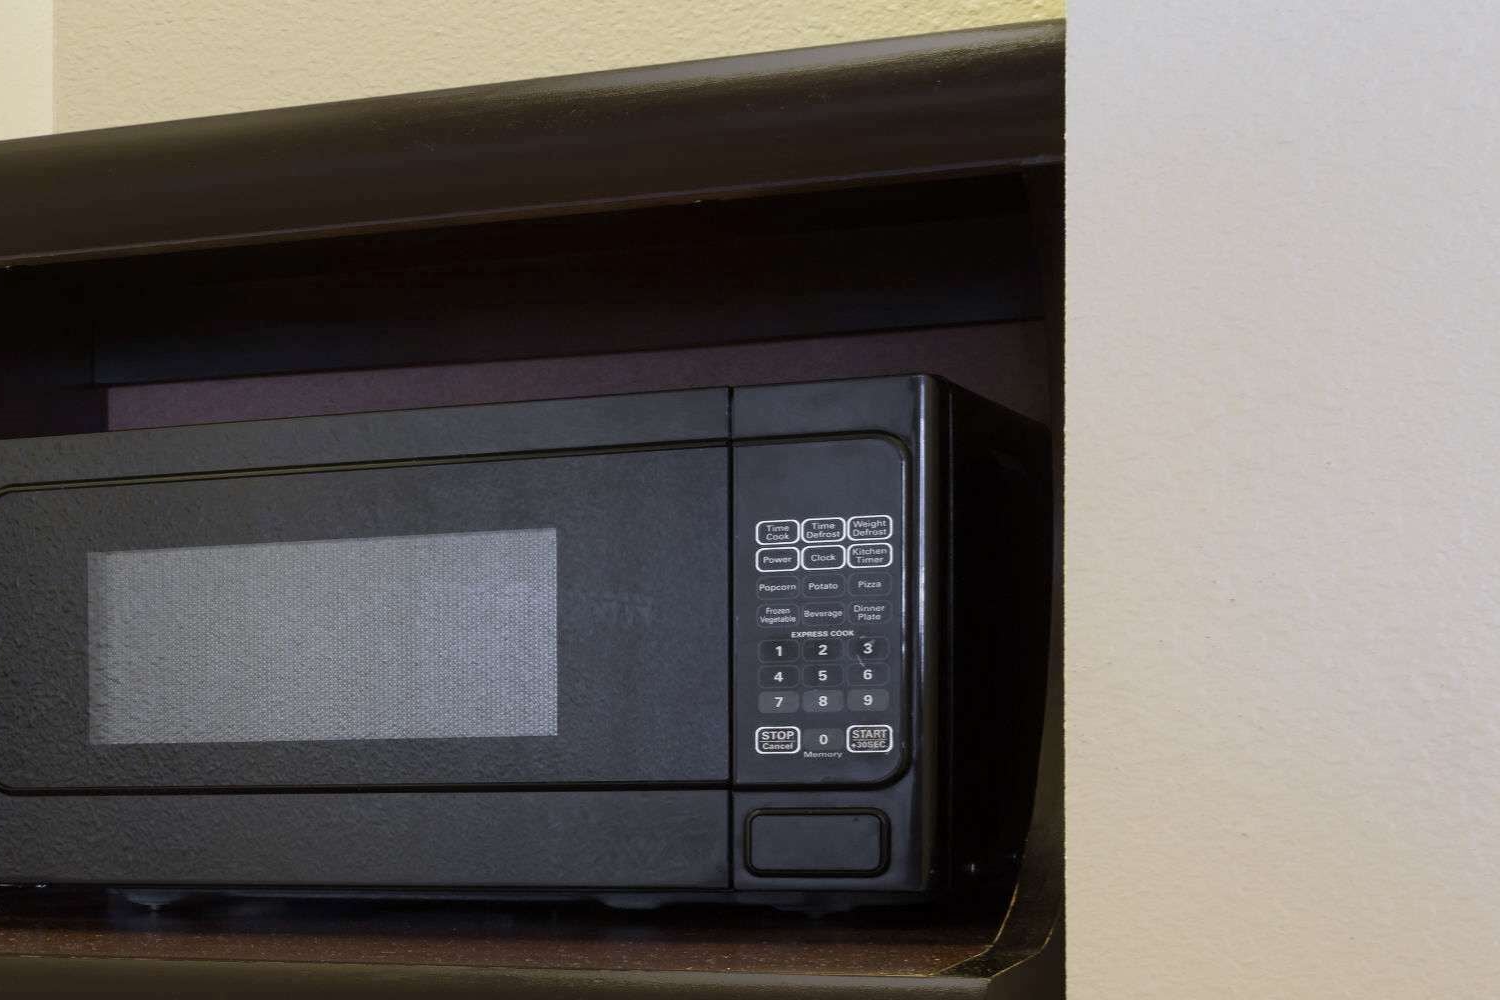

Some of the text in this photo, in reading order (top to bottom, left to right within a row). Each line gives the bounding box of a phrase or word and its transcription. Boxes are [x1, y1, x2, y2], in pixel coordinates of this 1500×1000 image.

[853, 520, 887, 528] Weight
[806, 531, 840, 539] Defrost
[853, 548, 887, 556] Kitchen
[811, 554, 836, 562] Clock
[759, 584, 796, 592] Popcorn
[804, 610, 843, 618] Beverage
[760, 616, 796, 624] Vegetable
[775, 646, 783, 656] 1
[818, 645, 828, 655] 2
[863, 643, 873, 654] 3
[774, 672, 784, 682] 4
[818, 670, 828, 681] 5
[863, 669, 873, 680] 6
[774, 697, 784, 707] 7
[818, 696, 828, 706] 8
[863, 695, 873, 706] 9
[761, 731, 794, 740] STOP
[852, 730, 887, 739] START
[819, 734, 828, 745] 0
[804, 751, 842, 759] Memory
